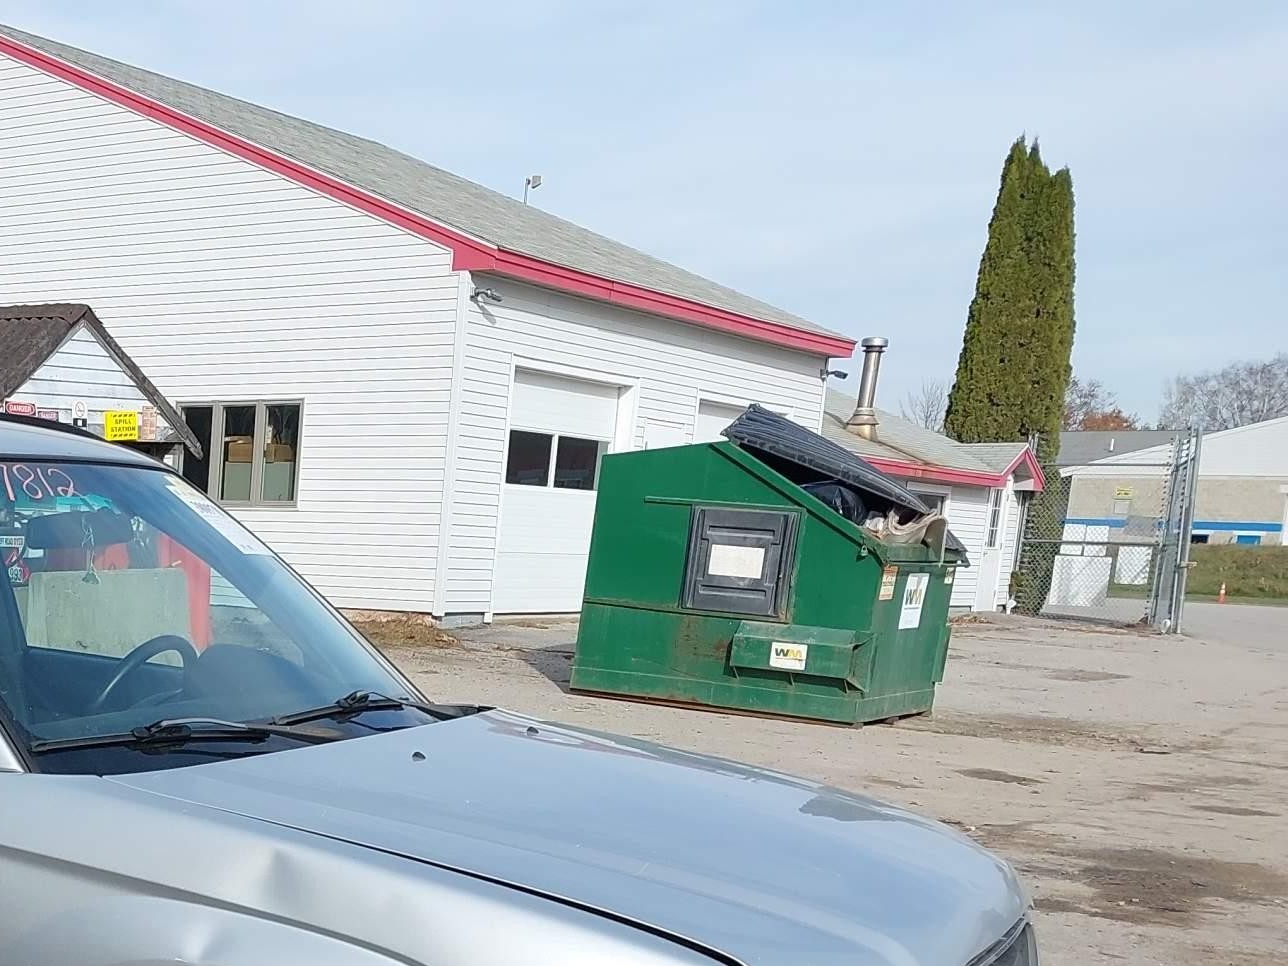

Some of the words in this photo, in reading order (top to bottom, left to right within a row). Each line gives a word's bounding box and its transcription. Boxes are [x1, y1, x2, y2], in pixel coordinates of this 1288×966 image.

[9, 404, 31, 413] DANGER
[904, 589, 923, 606] WM
[775, 647, 802, 658] WM
